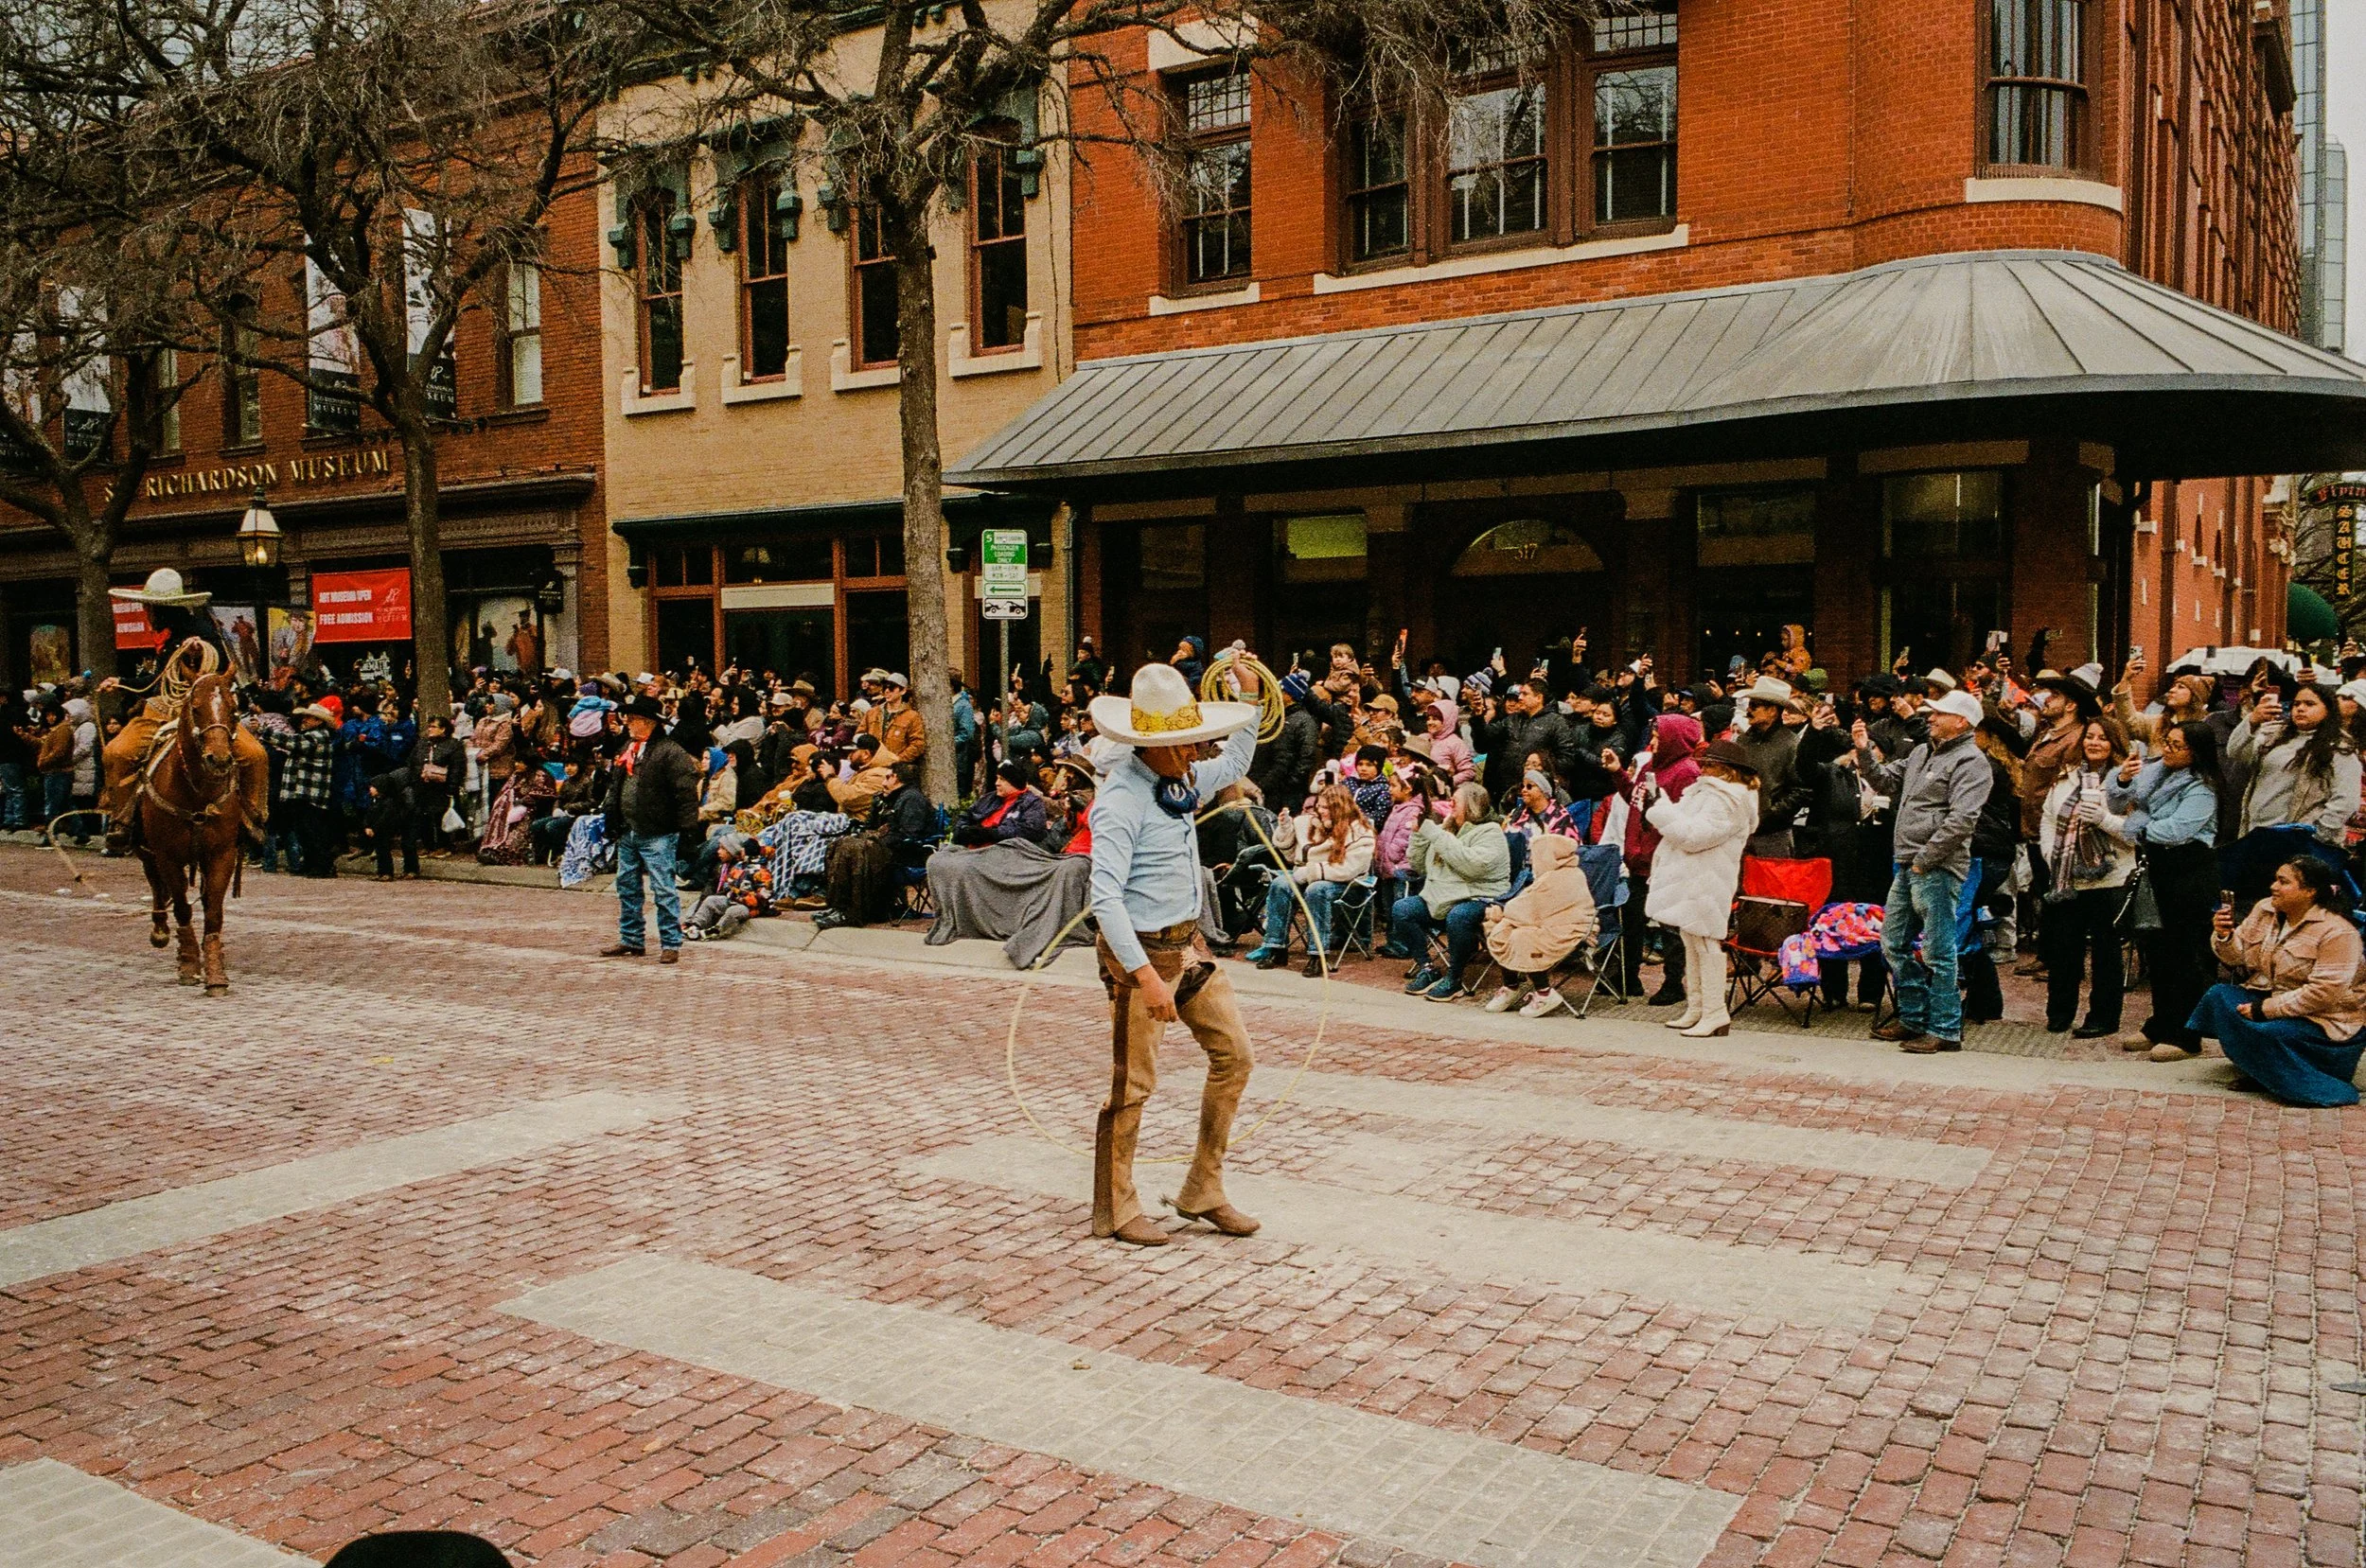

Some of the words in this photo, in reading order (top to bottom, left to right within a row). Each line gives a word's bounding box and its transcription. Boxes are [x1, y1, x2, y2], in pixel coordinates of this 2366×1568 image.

[146, 464, 277, 497] RICHARDSON
[291, 449, 389, 481] MUSEUM
[319, 613, 336, 625] FREE
[336, 611, 374, 625] ADMISSION
